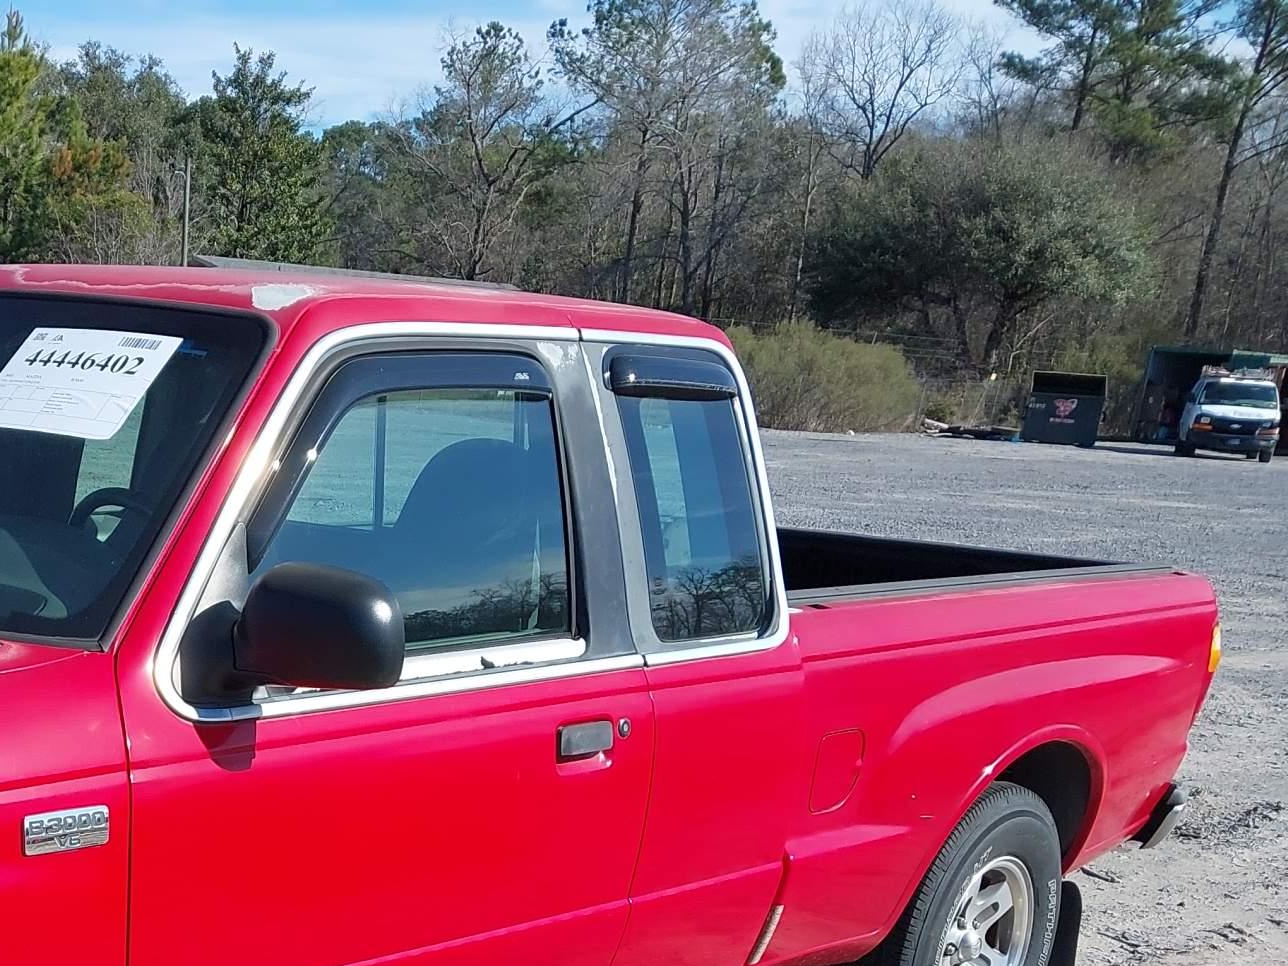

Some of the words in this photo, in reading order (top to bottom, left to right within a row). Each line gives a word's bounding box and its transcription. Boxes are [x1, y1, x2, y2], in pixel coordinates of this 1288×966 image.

[24, 348, 145, 375] 44446402
[28, 811, 107, 836] B3000
[54, 833, 81, 848] V6
